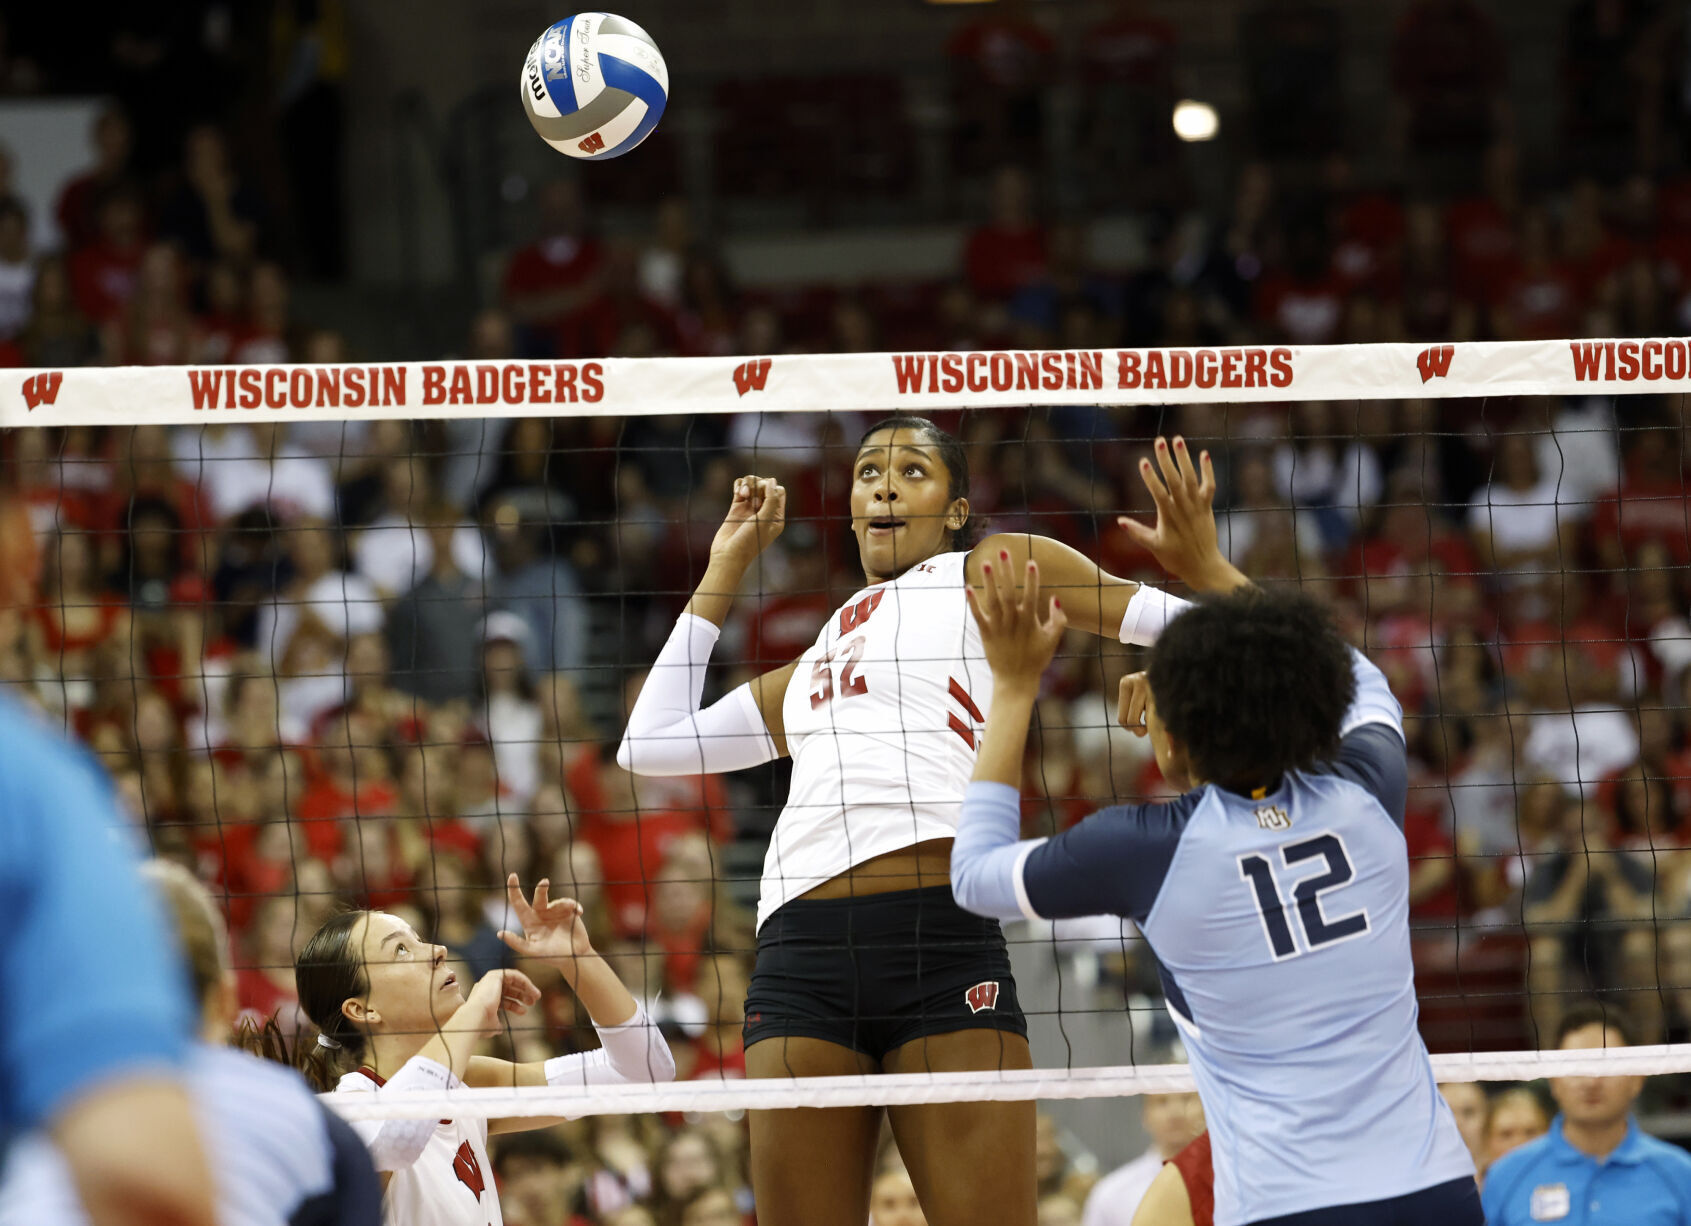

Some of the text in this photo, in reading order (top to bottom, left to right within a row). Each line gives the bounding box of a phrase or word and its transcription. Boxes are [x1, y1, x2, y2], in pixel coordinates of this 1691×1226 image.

[544, 25, 566, 82] NCAA
[576, 48, 594, 83] Super
[732, 358, 772, 398] W
[892, 347, 1293, 394] WISCONSIN BADGERS
[1416, 344, 1455, 384] W
[1569, 340, 1691, 382] WISCO
[21, 372, 63, 412] W
[187, 362, 605, 410] WISCONSIN BADGERS
[809, 635, 869, 711] 52
[1236, 828, 1372, 963] 12
